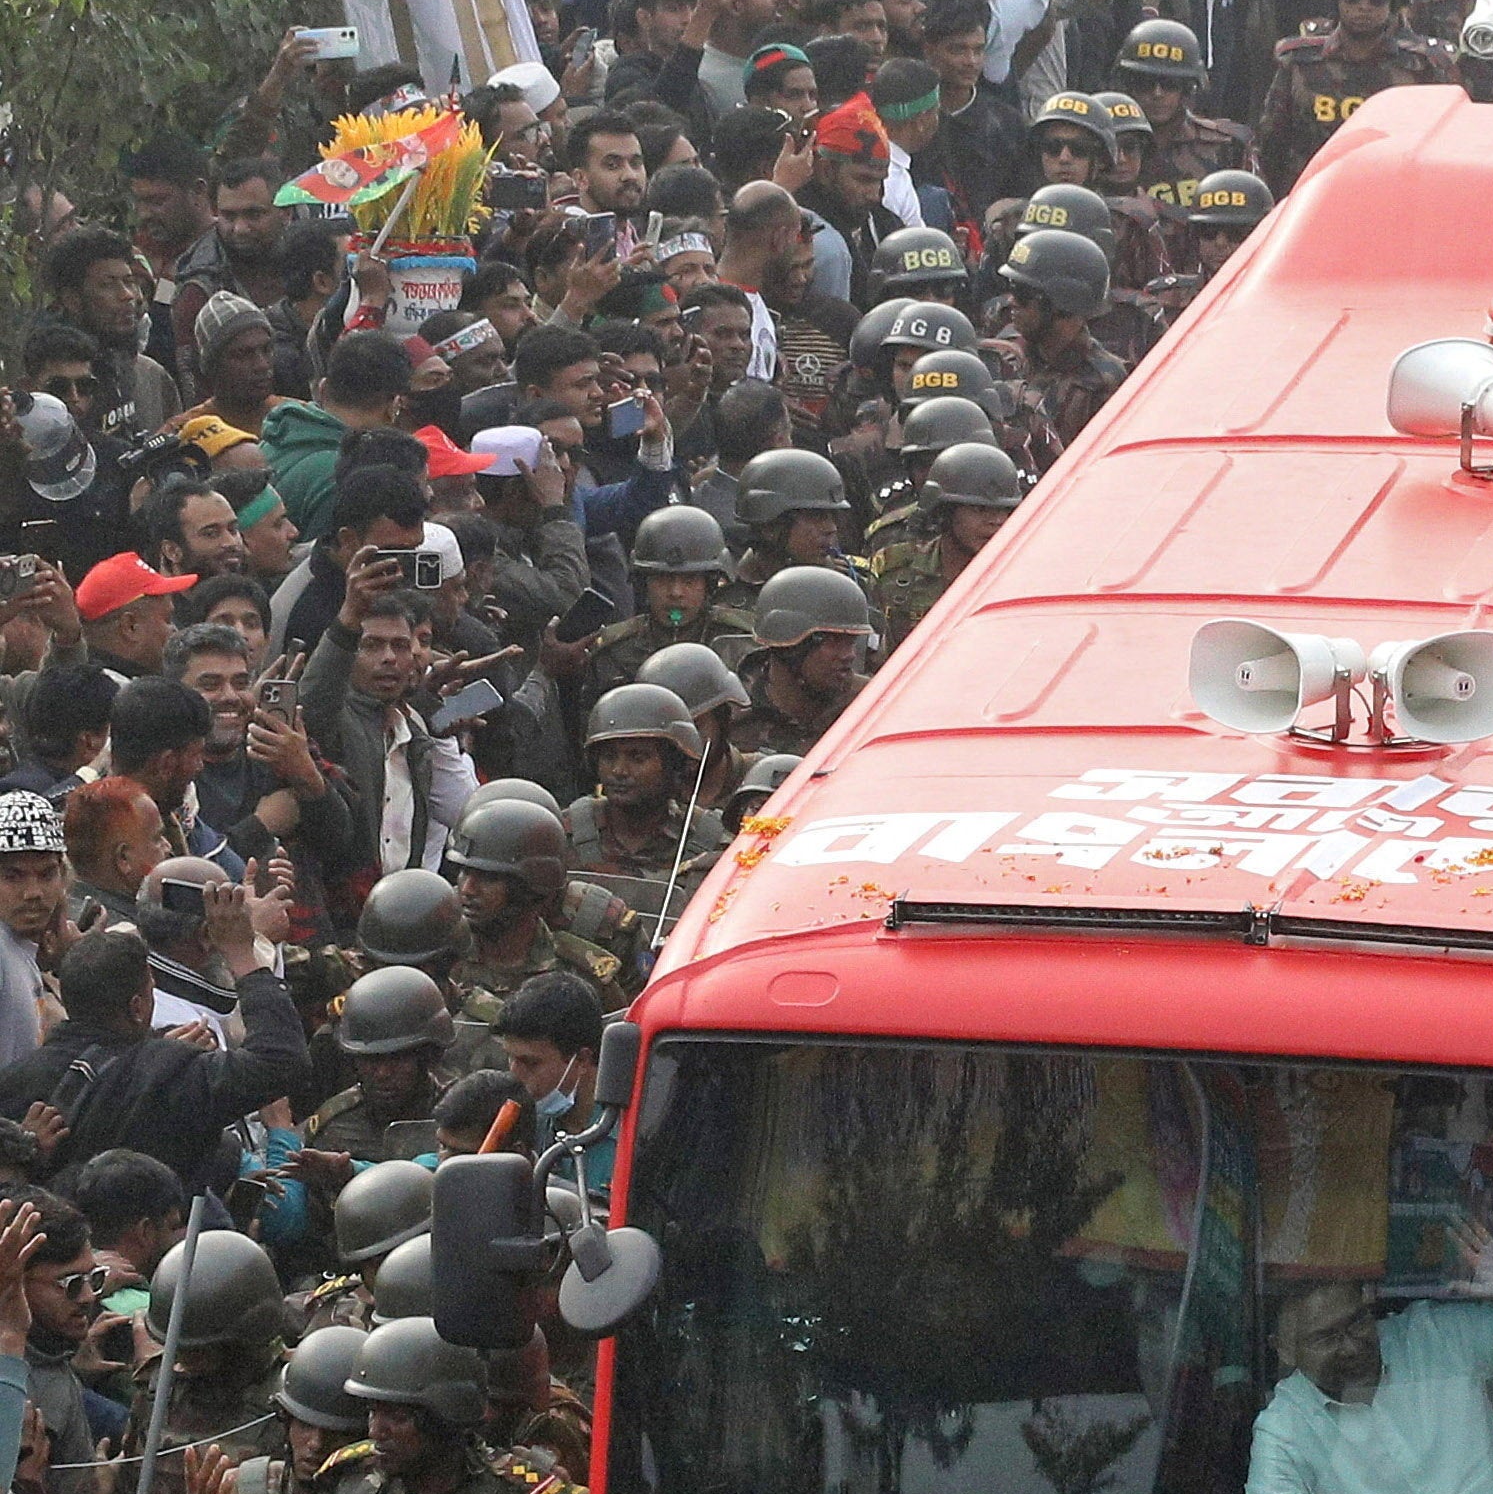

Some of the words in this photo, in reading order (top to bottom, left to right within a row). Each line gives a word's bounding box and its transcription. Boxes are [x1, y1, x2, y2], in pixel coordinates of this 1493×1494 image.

[1137, 43, 1184, 63] BGB
[1045, 97, 1089, 115] BGB
[1314, 94, 1365, 122] BG
[1199, 190, 1246, 209] BGB
[1024, 204, 1068, 227] BGB
[903, 248, 953, 271] BGB
[890, 318, 952, 345] BGB
[911, 371, 957, 390] BGB
